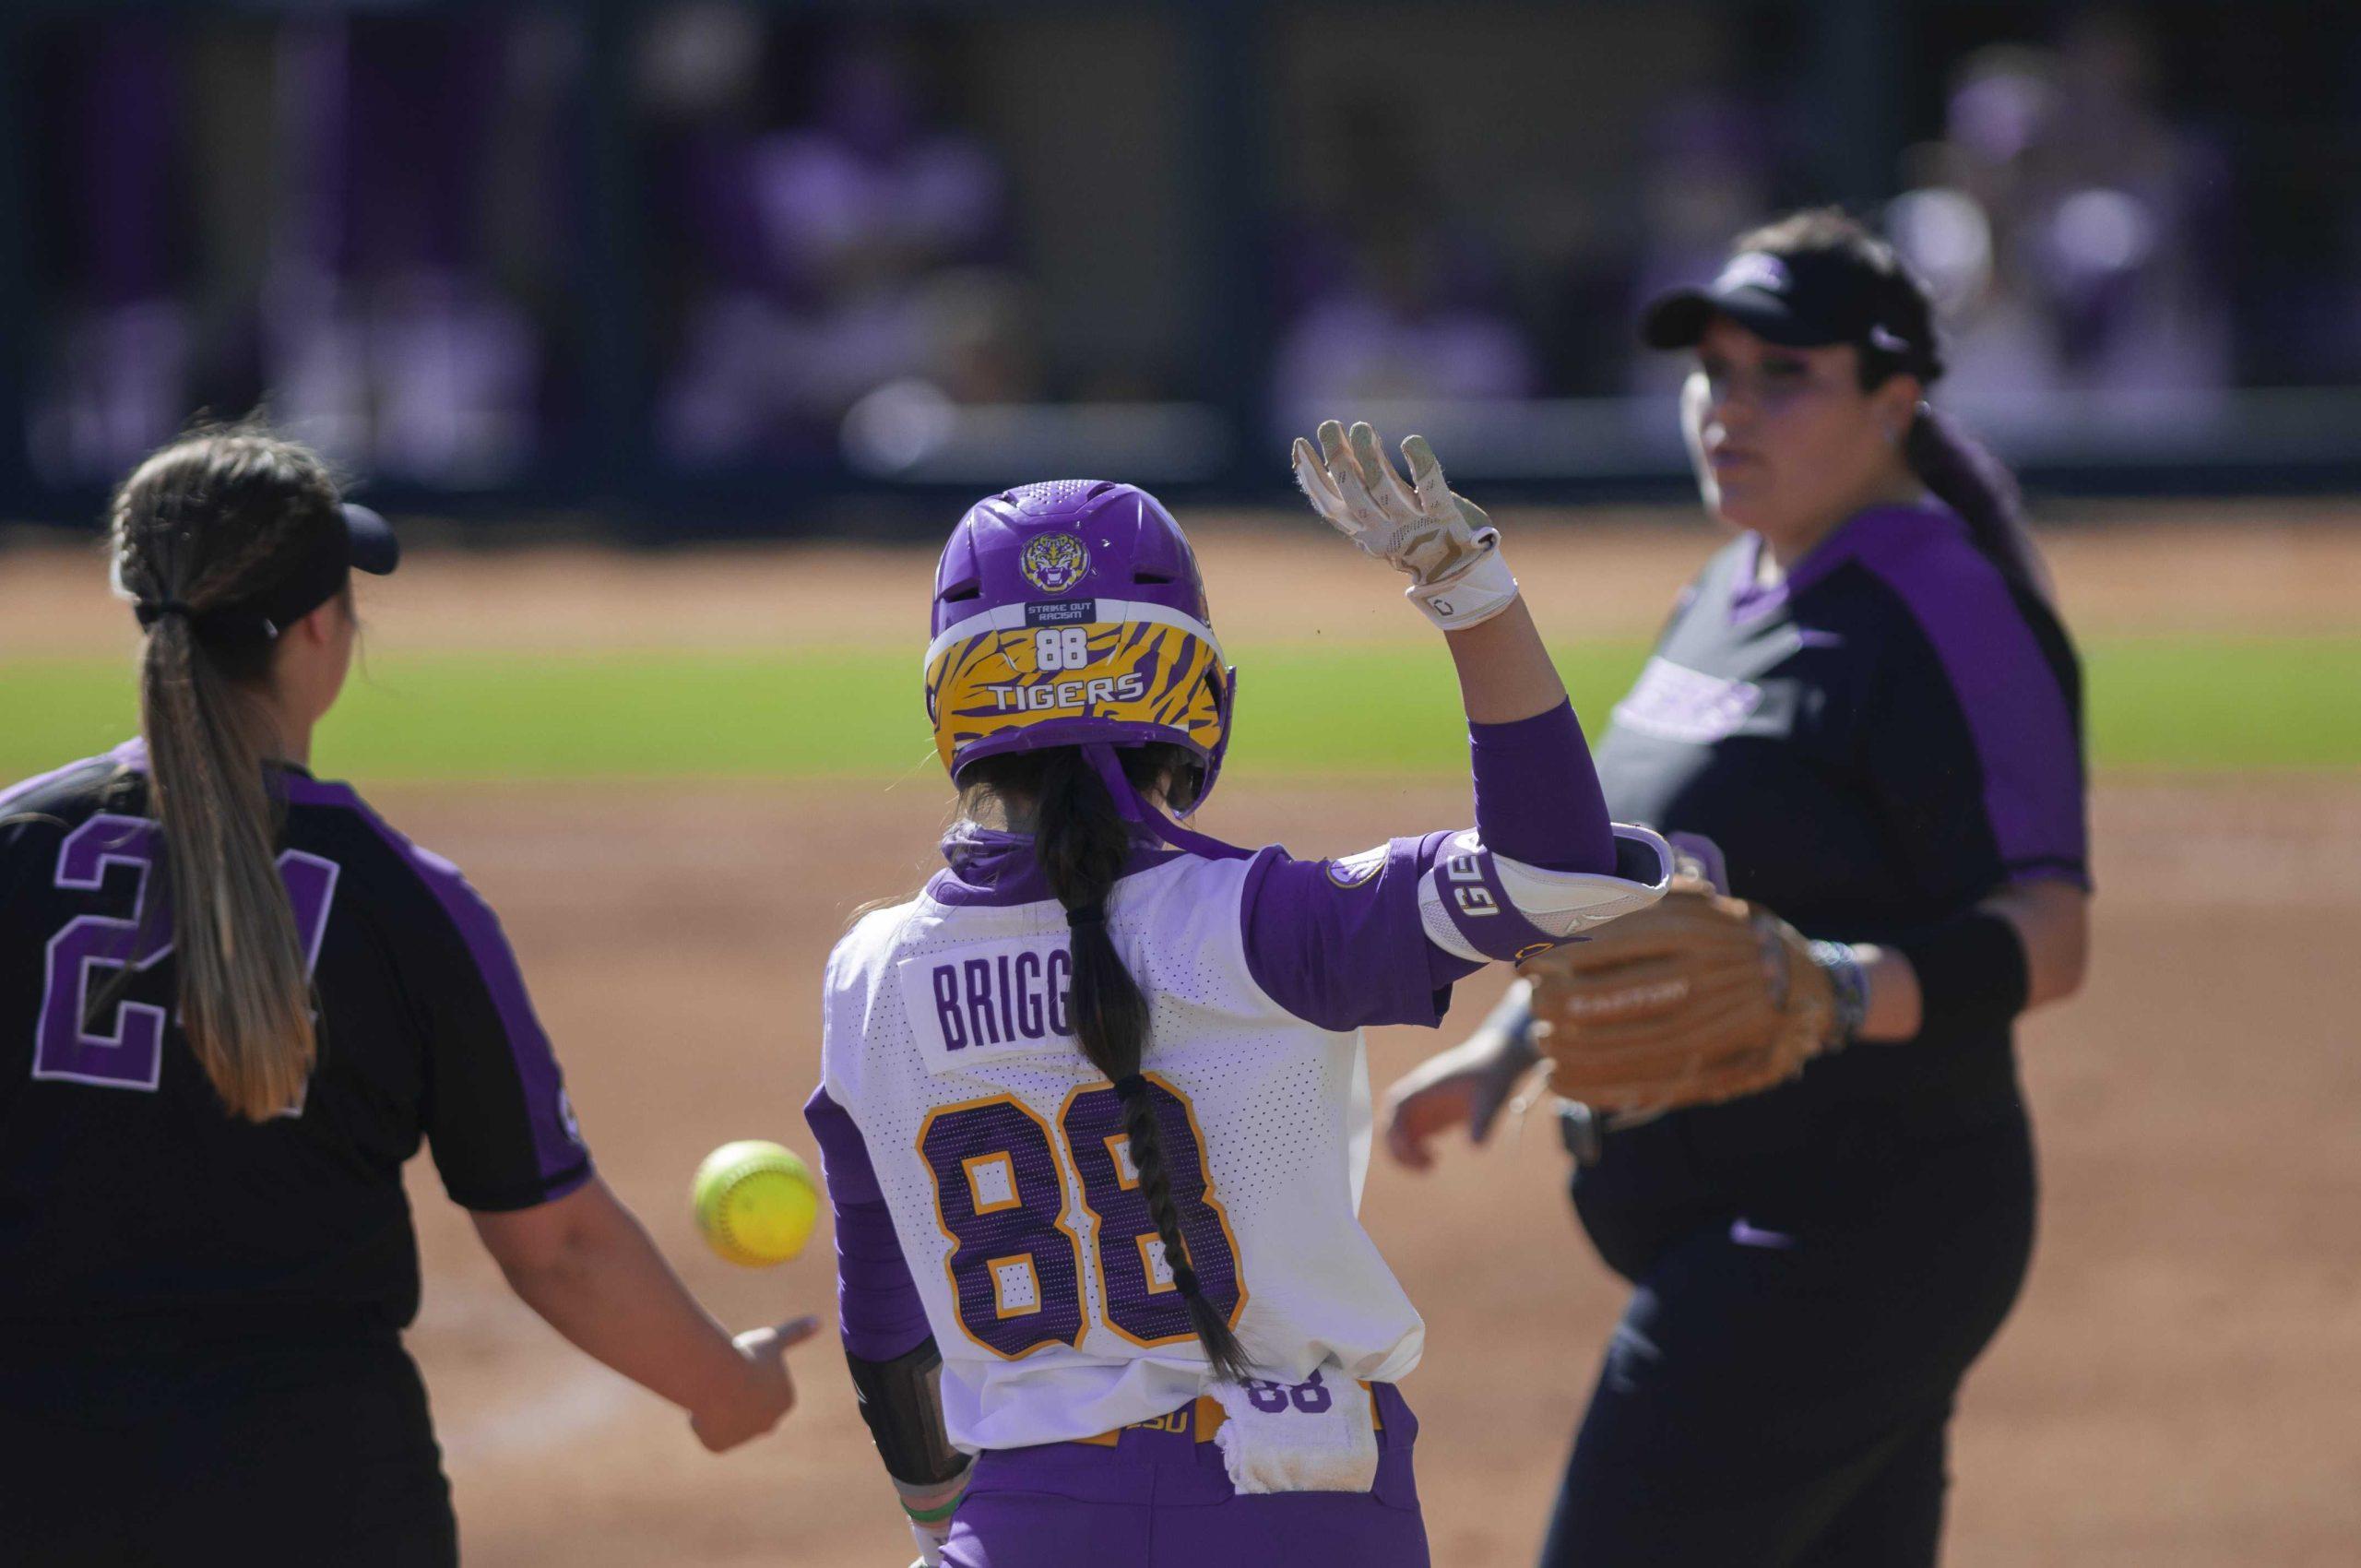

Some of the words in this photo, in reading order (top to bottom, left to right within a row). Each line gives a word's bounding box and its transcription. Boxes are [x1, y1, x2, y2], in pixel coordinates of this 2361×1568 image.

[1028, 604, 1067, 614] STRIKE
[1070, 602, 1092, 611] OUT
[1038, 611, 1082, 621] RACISM
[1036, 628, 1087, 671] 88
[987, 672, 1144, 710] TIGERS
[933, 949, 1073, 1051] BRIGG
[915, 1072, 1250, 1361] 88
